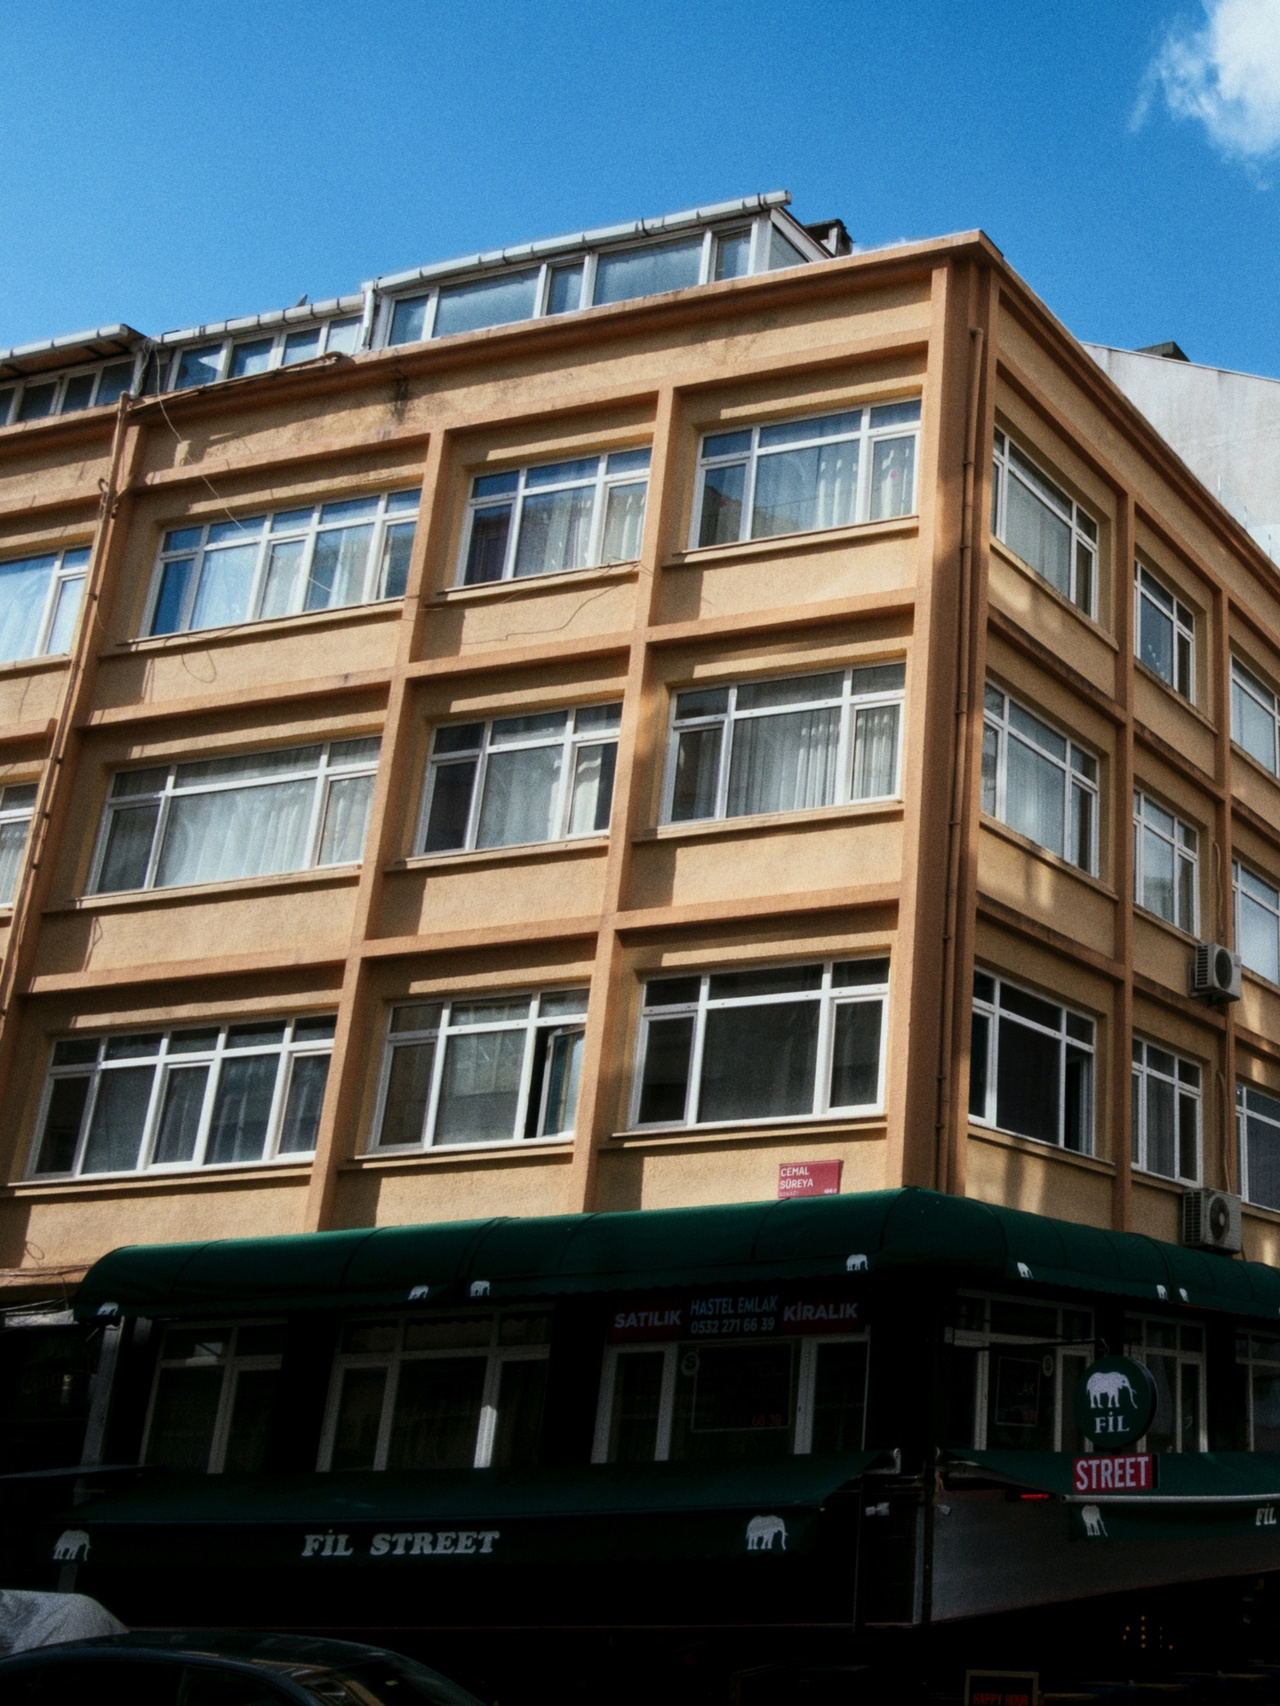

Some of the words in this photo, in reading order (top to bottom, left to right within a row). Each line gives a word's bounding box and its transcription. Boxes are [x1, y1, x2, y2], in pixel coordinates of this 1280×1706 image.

[780, 1166, 810, 1177] CEMAL
[690, 1298, 735, 1316] HASTEL
[737, 1294, 779, 1314] EMLAK
[782, 1301, 859, 1322] KİRALIK
[614, 1309, 683, 1329] SATILIK
[690, 1319, 719, 1335] 0532
[721, 1318, 741, 1333] 271
[743, 1317, 758, 1332] 66
[760, 1316, 776, 1331] 39
[1094, 1411, 1130, 1434] FİL
[1076, 1456, 1149, 1491] STREET
[1255, 1502, 1277, 1527] FİL
[301, 1528, 354, 1557] FİL
[369, 1530, 500, 1556] STREET
